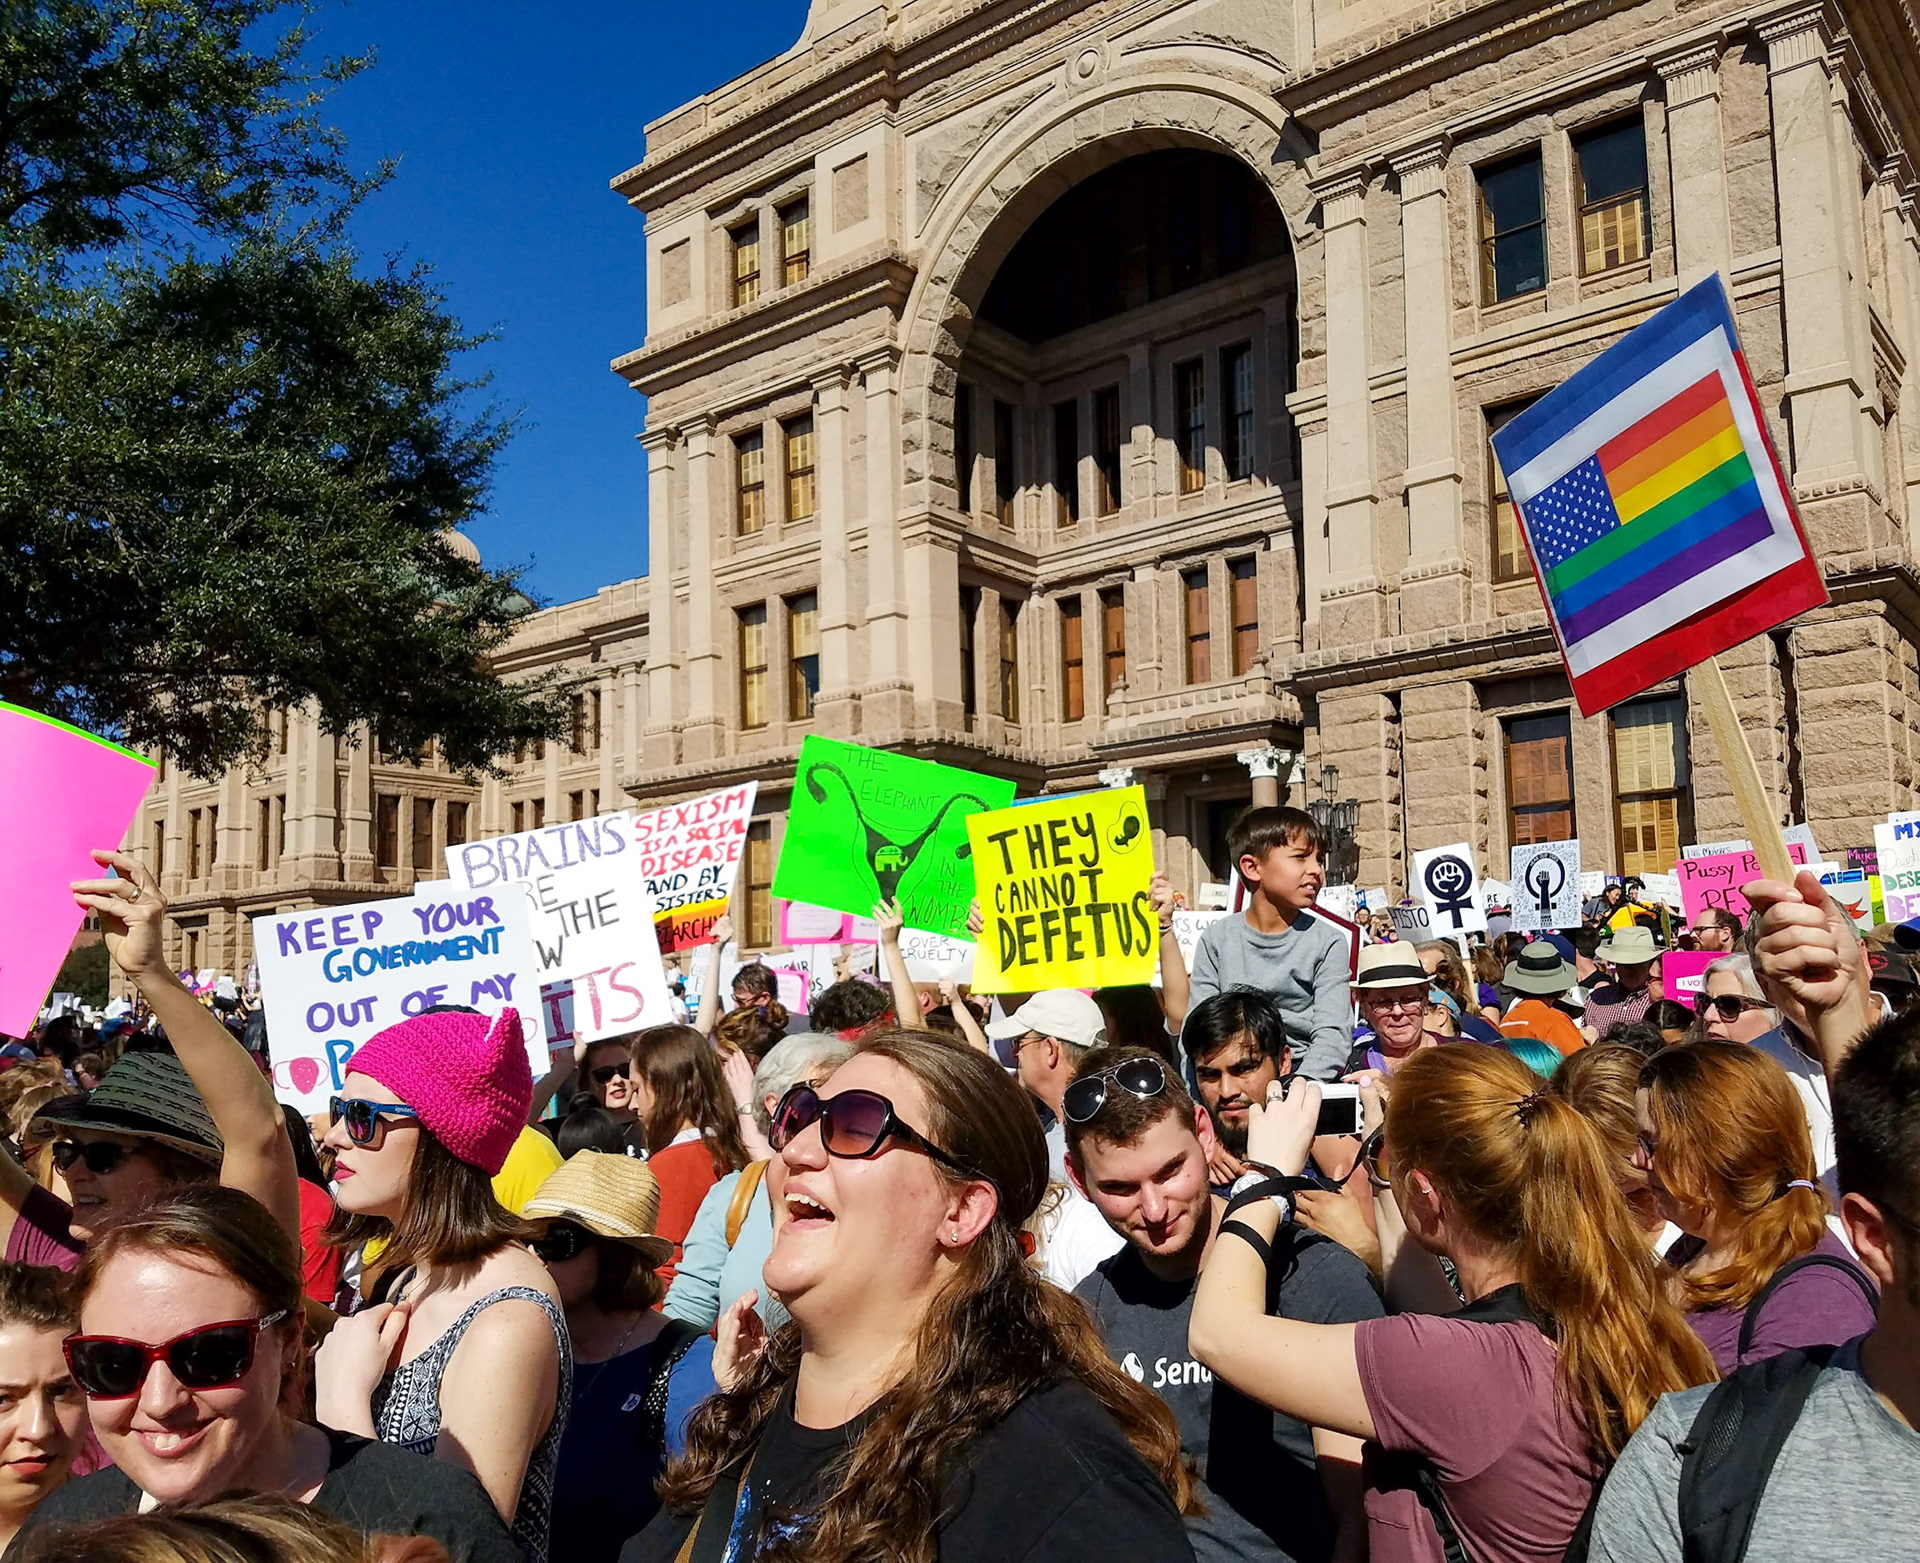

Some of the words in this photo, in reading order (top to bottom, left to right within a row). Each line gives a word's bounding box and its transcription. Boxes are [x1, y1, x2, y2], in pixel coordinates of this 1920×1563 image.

[843, 747, 889, 773] THE
[860, 778, 941, 813] ELEPHANT
[635, 788, 748, 842] SEXISM
[461, 816, 626, 889] BRAINS
[640, 838, 662, 856] IS
[663, 834, 678, 849] A
[641, 840, 741, 878] DISEASE
[987, 811, 1101, 876] THEY
[644, 872, 688, 897] AND
[698, 863, 724, 888] BY
[939, 856, 956, 878] IN
[1683, 862, 1734, 884] Pussy
[515, 874, 558, 911] RE
[654, 882, 729, 915] SISTERS
[937, 879, 965, 898] THE
[995, 868, 1104, 915] CANNOT
[276, 910, 384, 957] KEEP
[412, 896, 501, 936] YOUR
[545, 889, 620, 938] THE
[1387, 906, 1430, 930] HISTO
[909, 936, 951, 949] OVER
[996, 891, 1152, 974] DEFETUS
[322, 926, 505, 983] GOVERNMENT
[540, 961, 644, 1041] ITS
[1687, 979, 1701, 987] VO
[306, 996, 378, 1033] OUT
[400, 984, 448, 1018] OF
[470, 973, 517, 1006] MY
